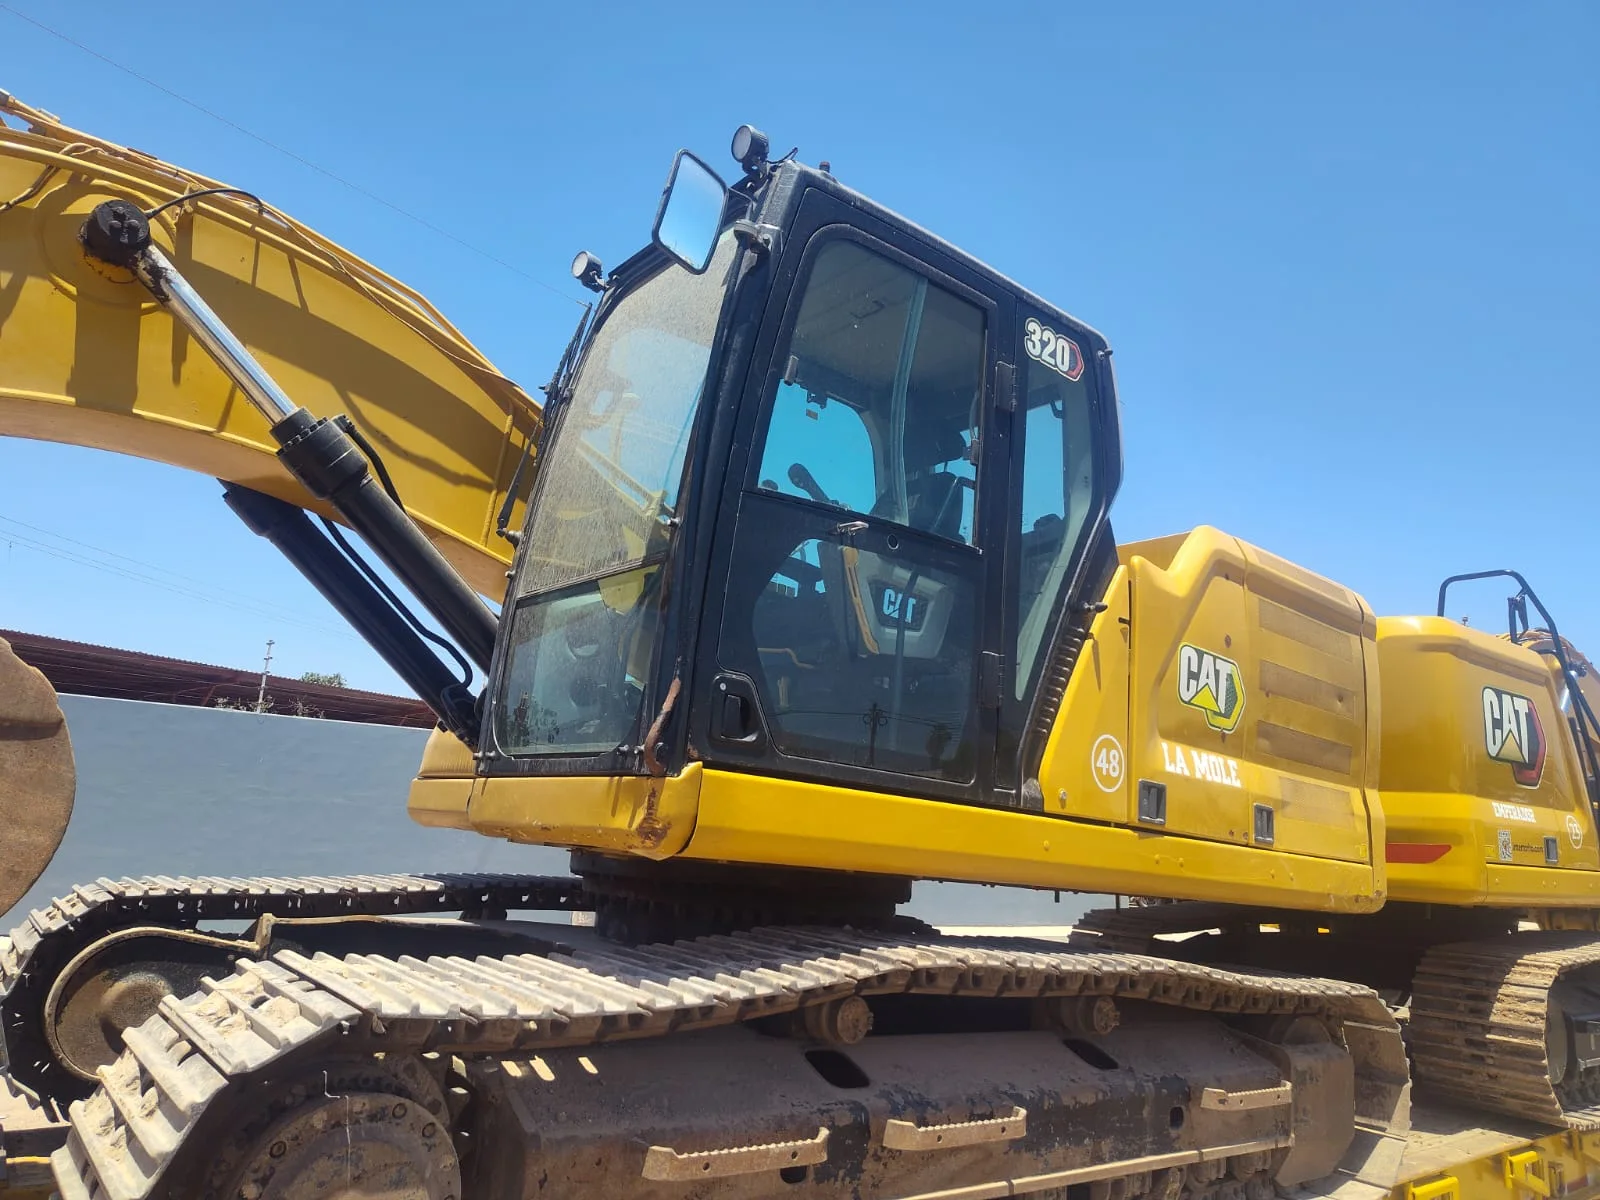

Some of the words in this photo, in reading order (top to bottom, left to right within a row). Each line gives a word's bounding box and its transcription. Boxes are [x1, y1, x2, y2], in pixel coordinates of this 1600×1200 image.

[1027, 321, 1070, 372] 320
[1180, 645, 1233, 714] CAT
[1483, 687, 1529, 764] CAT
[1096, 747, 1120, 777] 48
[1161, 741, 1191, 777] LA
[1191, 750, 1242, 788] MOLE
